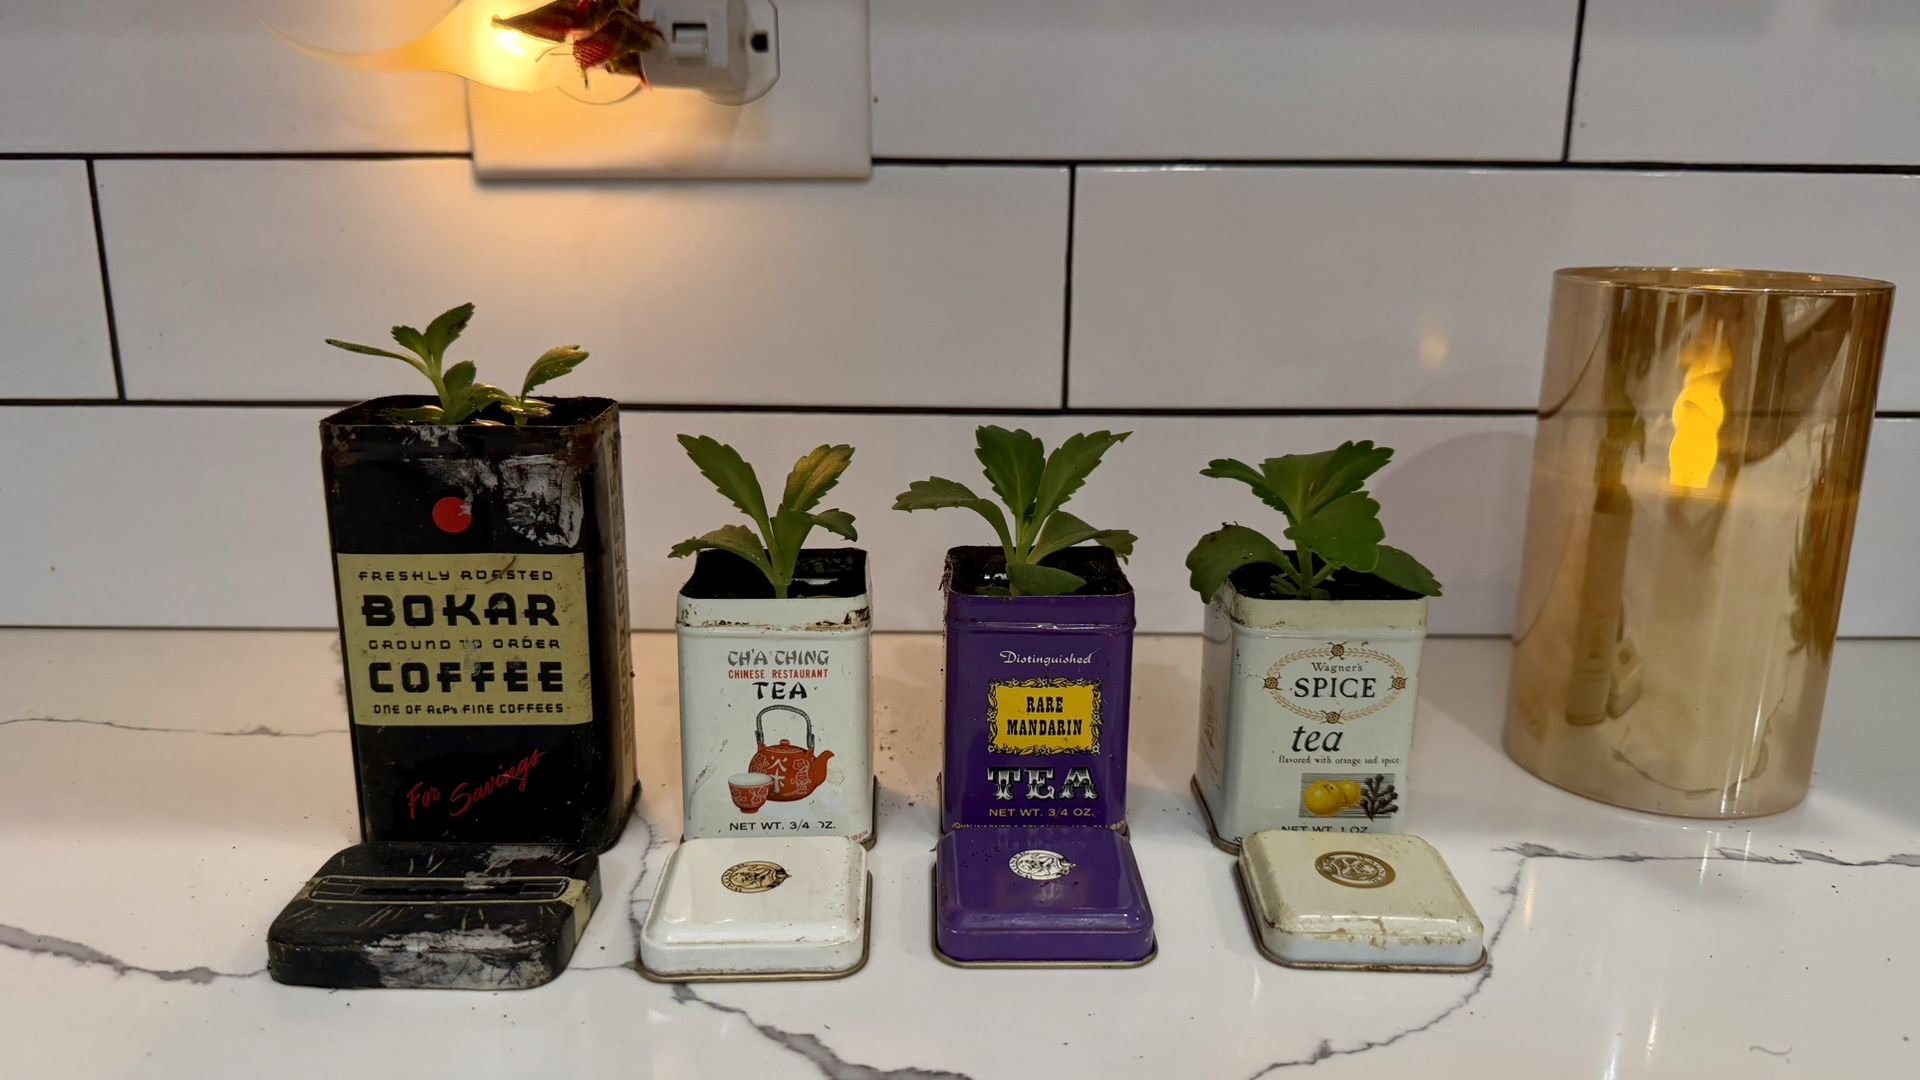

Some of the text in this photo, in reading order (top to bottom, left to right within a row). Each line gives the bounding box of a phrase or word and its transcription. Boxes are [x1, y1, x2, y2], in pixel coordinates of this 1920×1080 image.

[358, 570, 553, 581] FRESHLY ROASTED
[361, 592, 560, 627] BOKAR
[369, 639, 450, 650] GROUND
[493, 638, 560, 649] ORDER
[775, 650, 829, 666] CHING
[1000, 650, 1092, 666] Distinguished
[728, 669, 828, 679] CHINESE RESTAURANT
[1311, 662, 1363, 674] Wagner's
[369, 661, 563, 693] COFFEE
[752, 681, 808, 700] TEA
[1294, 677, 1377, 698] SPICE
[374, 704, 400, 714] ONE
[406, 704, 422, 714] OF
[462, 703, 494, 714] FINE
[500, 703, 563, 713] COFFEES
[1026, 696, 1064, 713] RARE
[1007, 719, 1082, 736] MANDARIN
[1292, 725, 1343, 752] tea
[1278, 755, 1400, 767] flavored with orange and spice
[406, 749, 546, 820] For Savings
[986, 765, 1099, 801] TEA
[989, 808, 1015, 817] NET
[1020, 808, 1043, 817] WT.
[1048, 808, 1069, 818] 3/4
[729, 821, 757, 831] NET
[761, 821, 785, 831] WT.
[789, 819, 810, 831] 3/4
